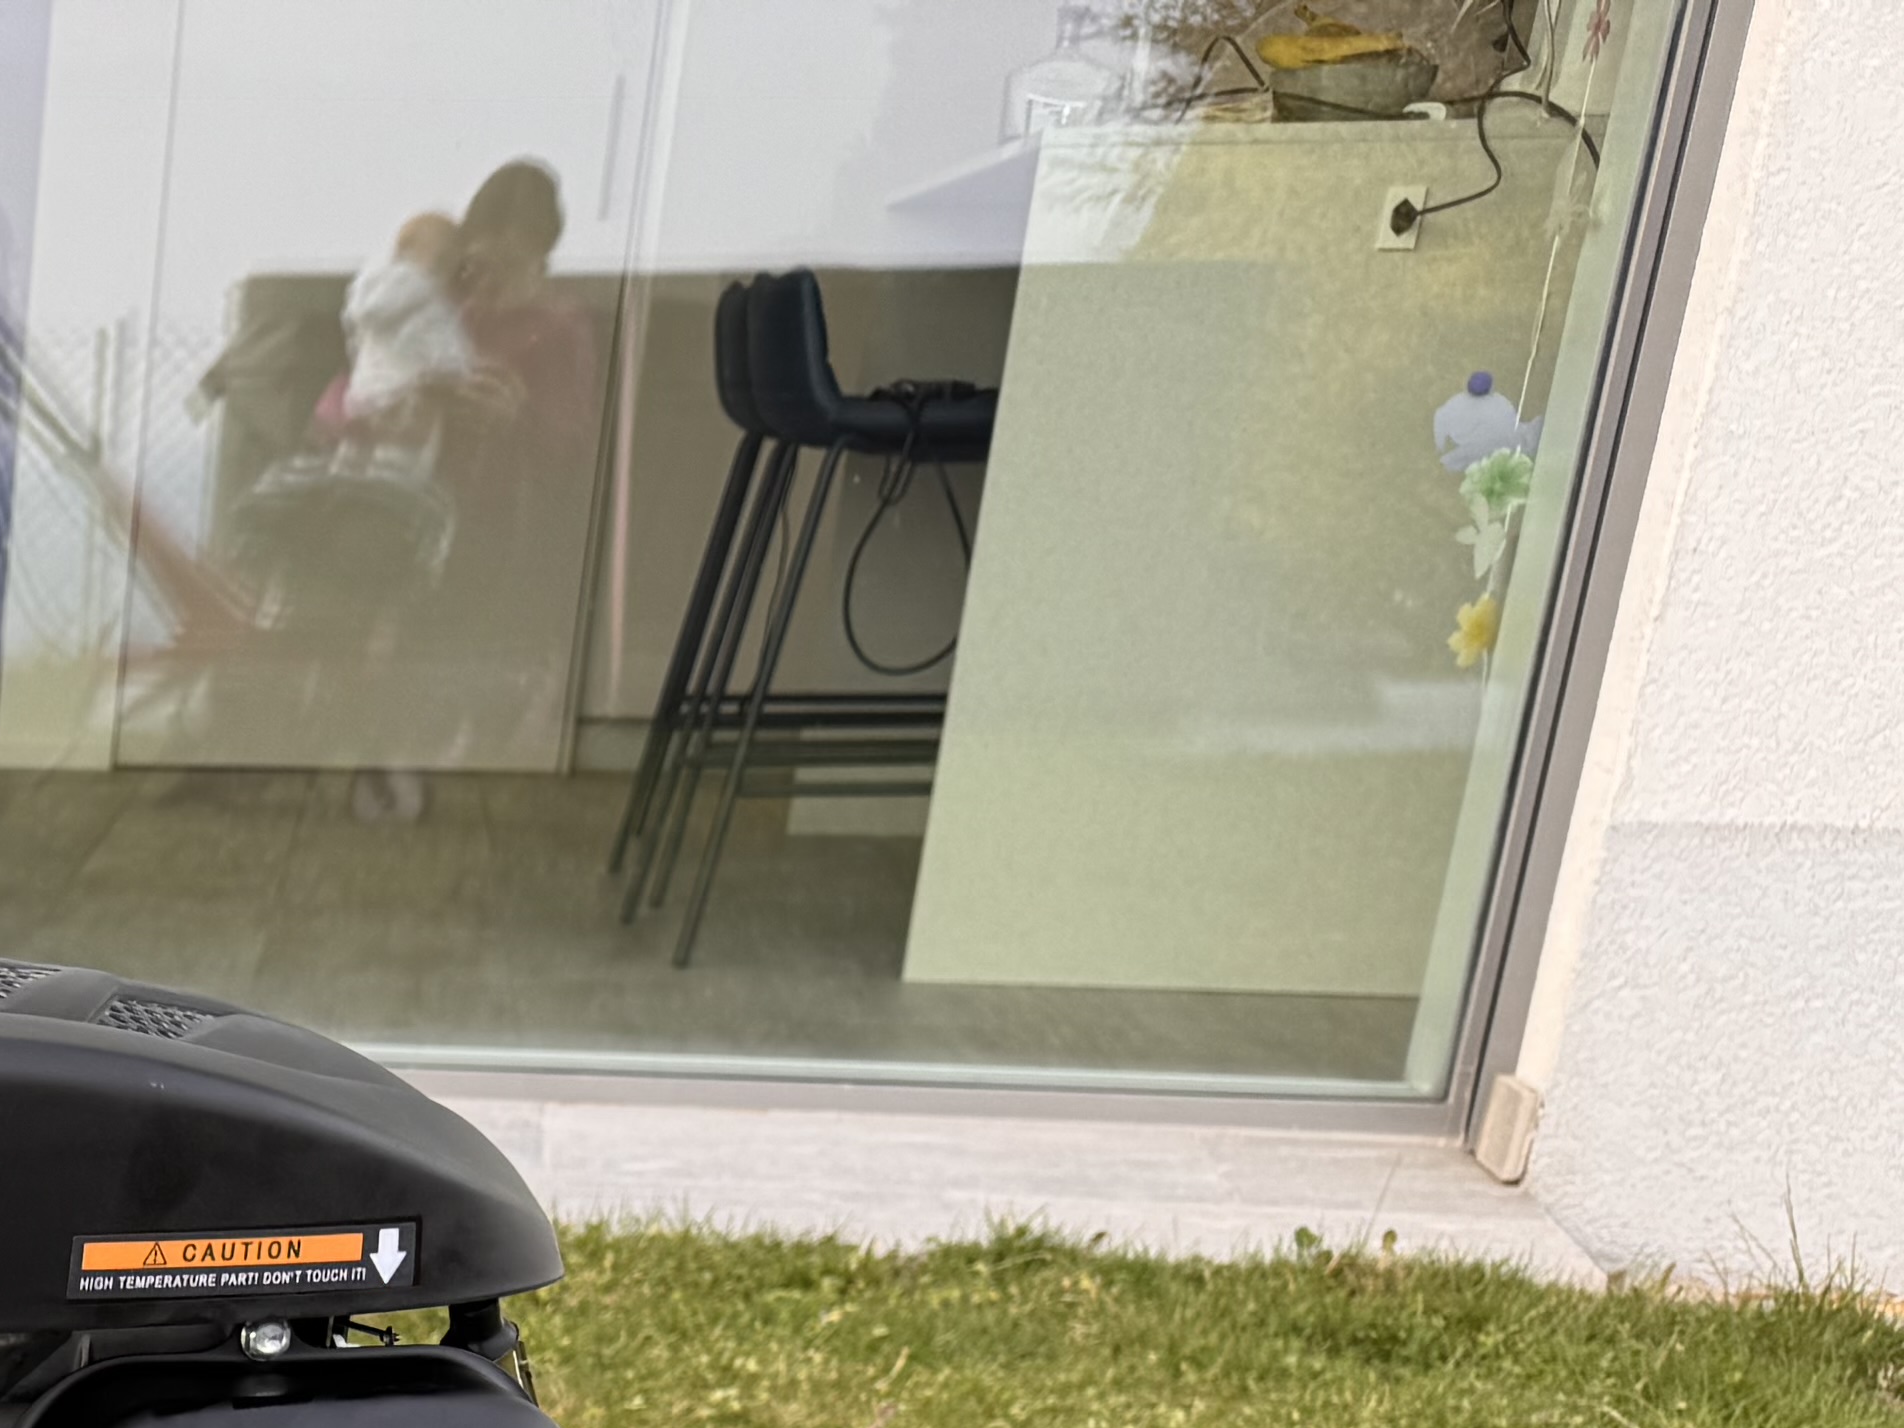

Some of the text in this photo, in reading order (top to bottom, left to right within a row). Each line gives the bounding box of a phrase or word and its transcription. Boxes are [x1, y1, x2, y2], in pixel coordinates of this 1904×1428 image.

[182, 1239, 301, 1262] CAUTION
[80, 1267, 366, 1291] HIGH TEMPERATURE PART! DON'T TOUCH IT!
